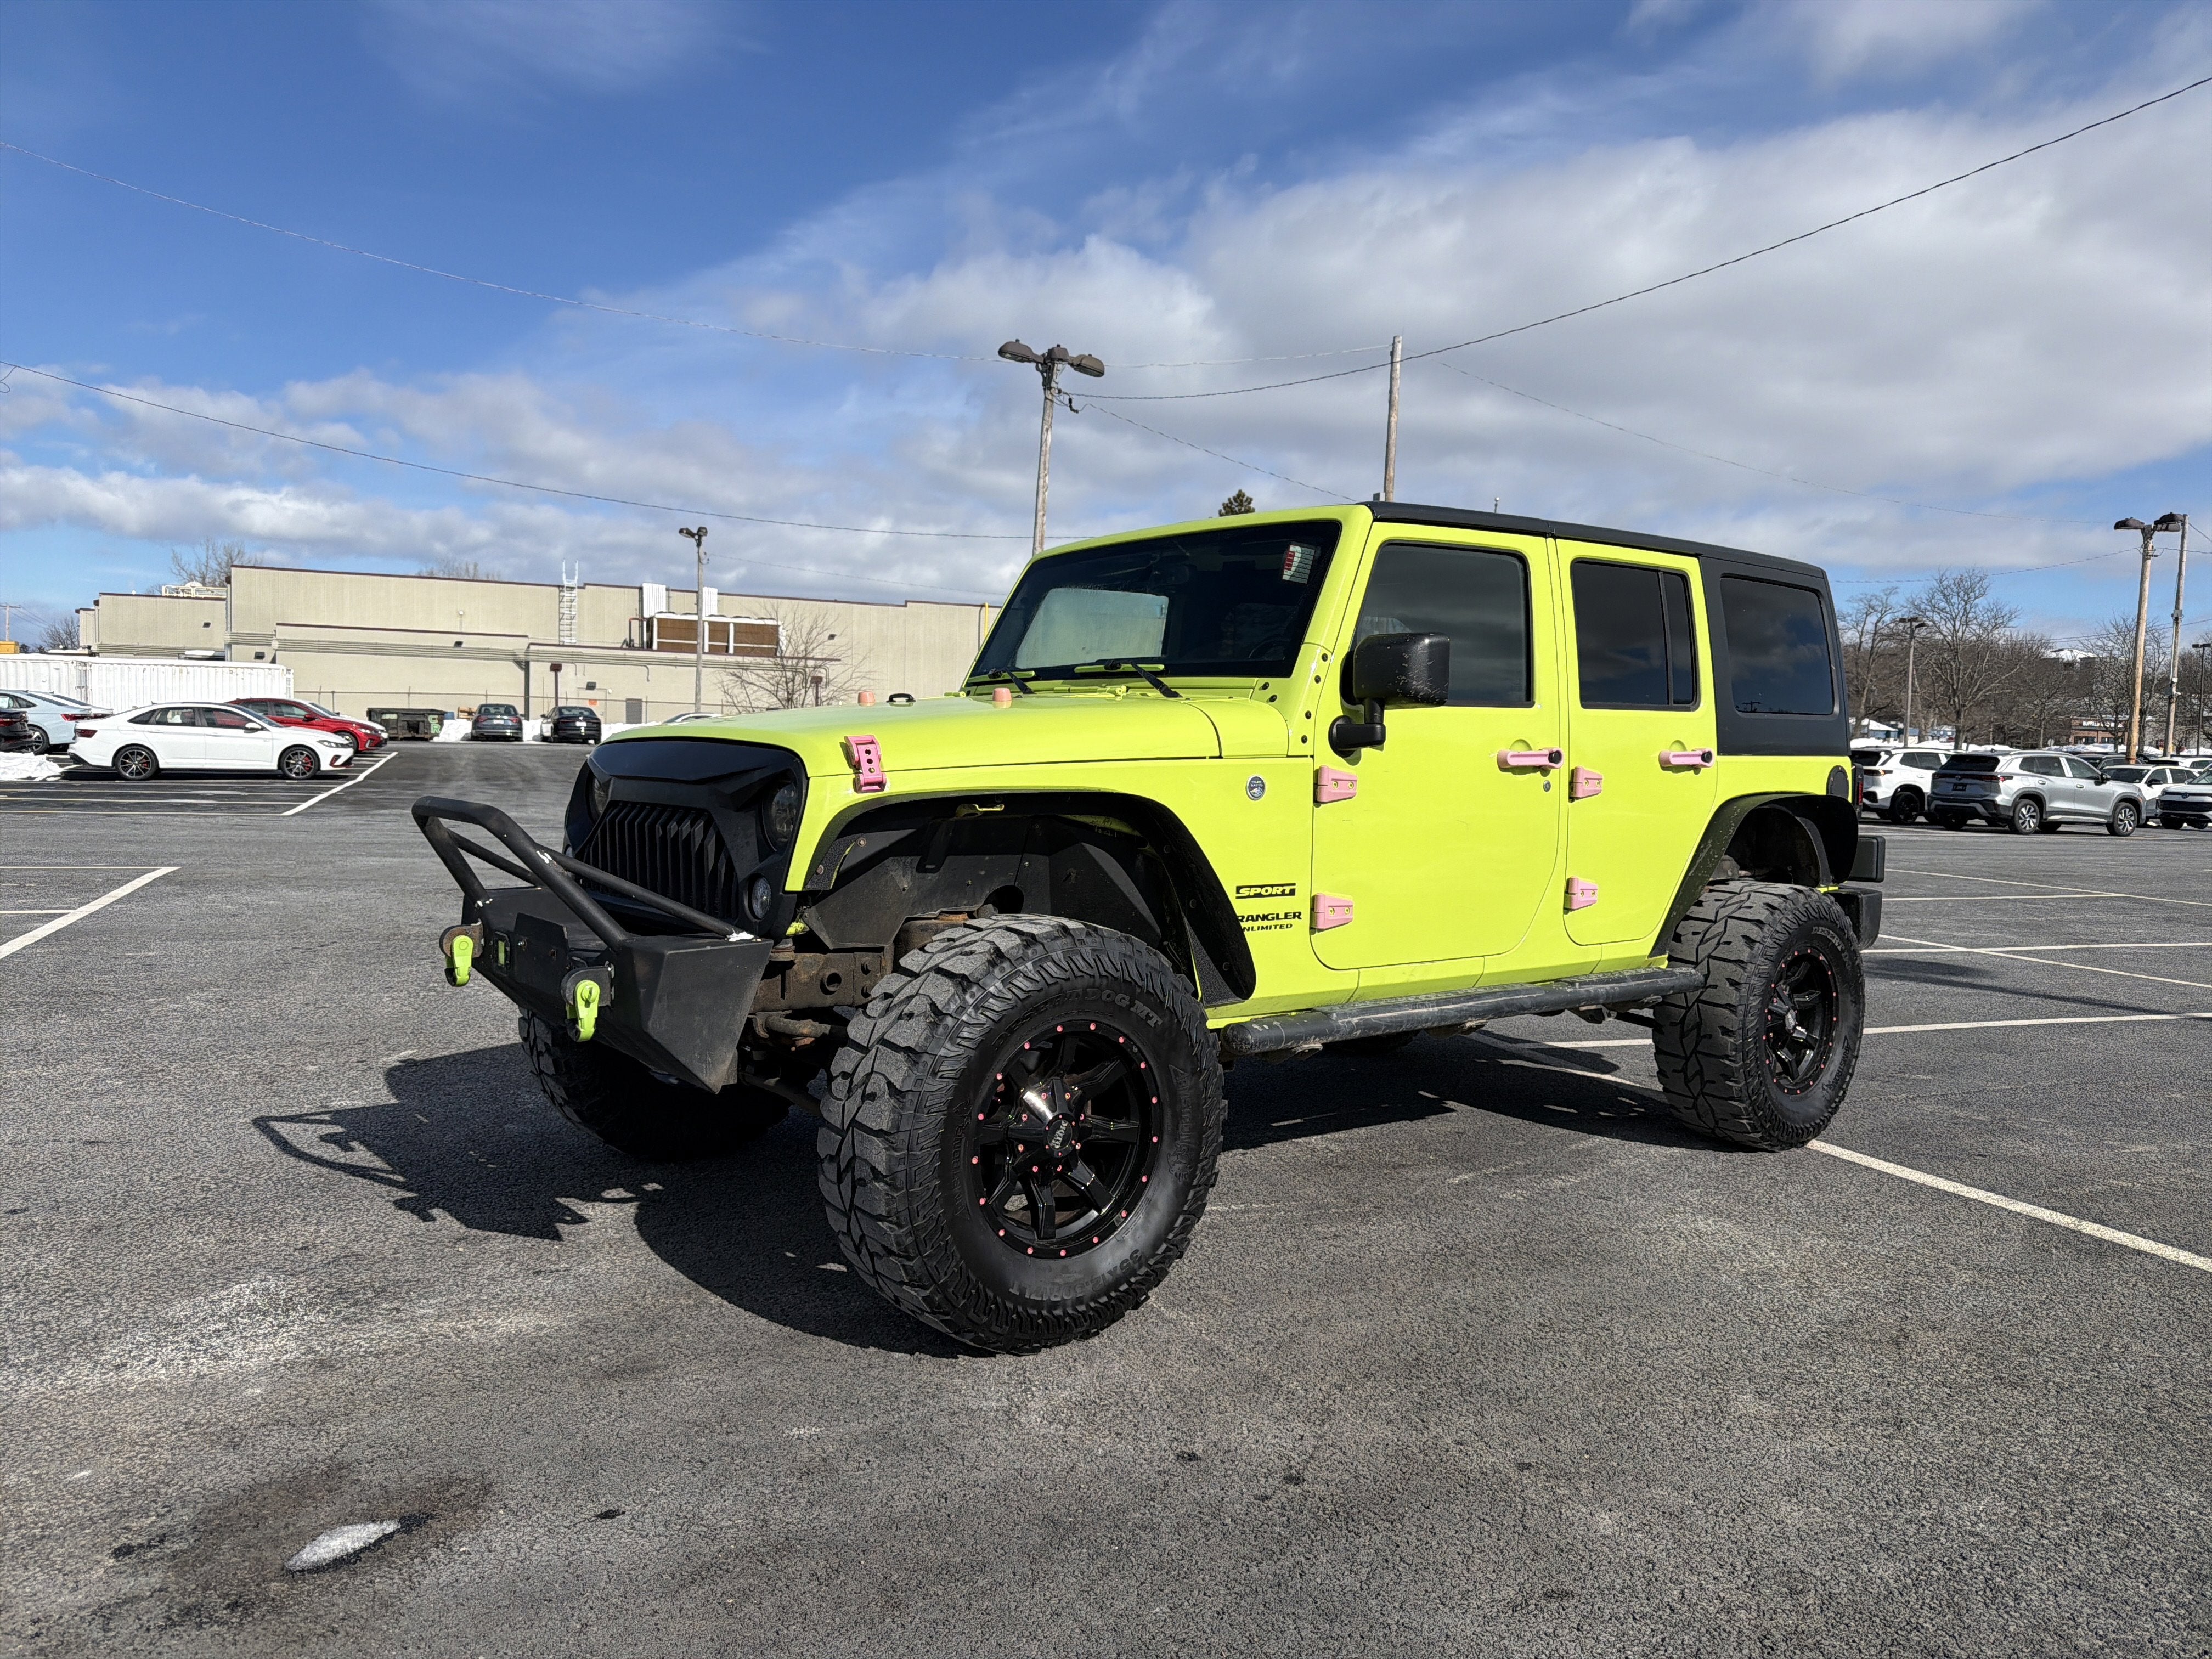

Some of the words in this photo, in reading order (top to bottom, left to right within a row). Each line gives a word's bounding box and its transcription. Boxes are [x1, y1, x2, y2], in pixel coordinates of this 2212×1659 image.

[1236, 885, 1295, 898] SPORT
[1237, 911, 1302, 922] RANGLER
[1242, 923, 1293, 932] NLIMITED
[1130, 1000, 1164, 1028] MT
